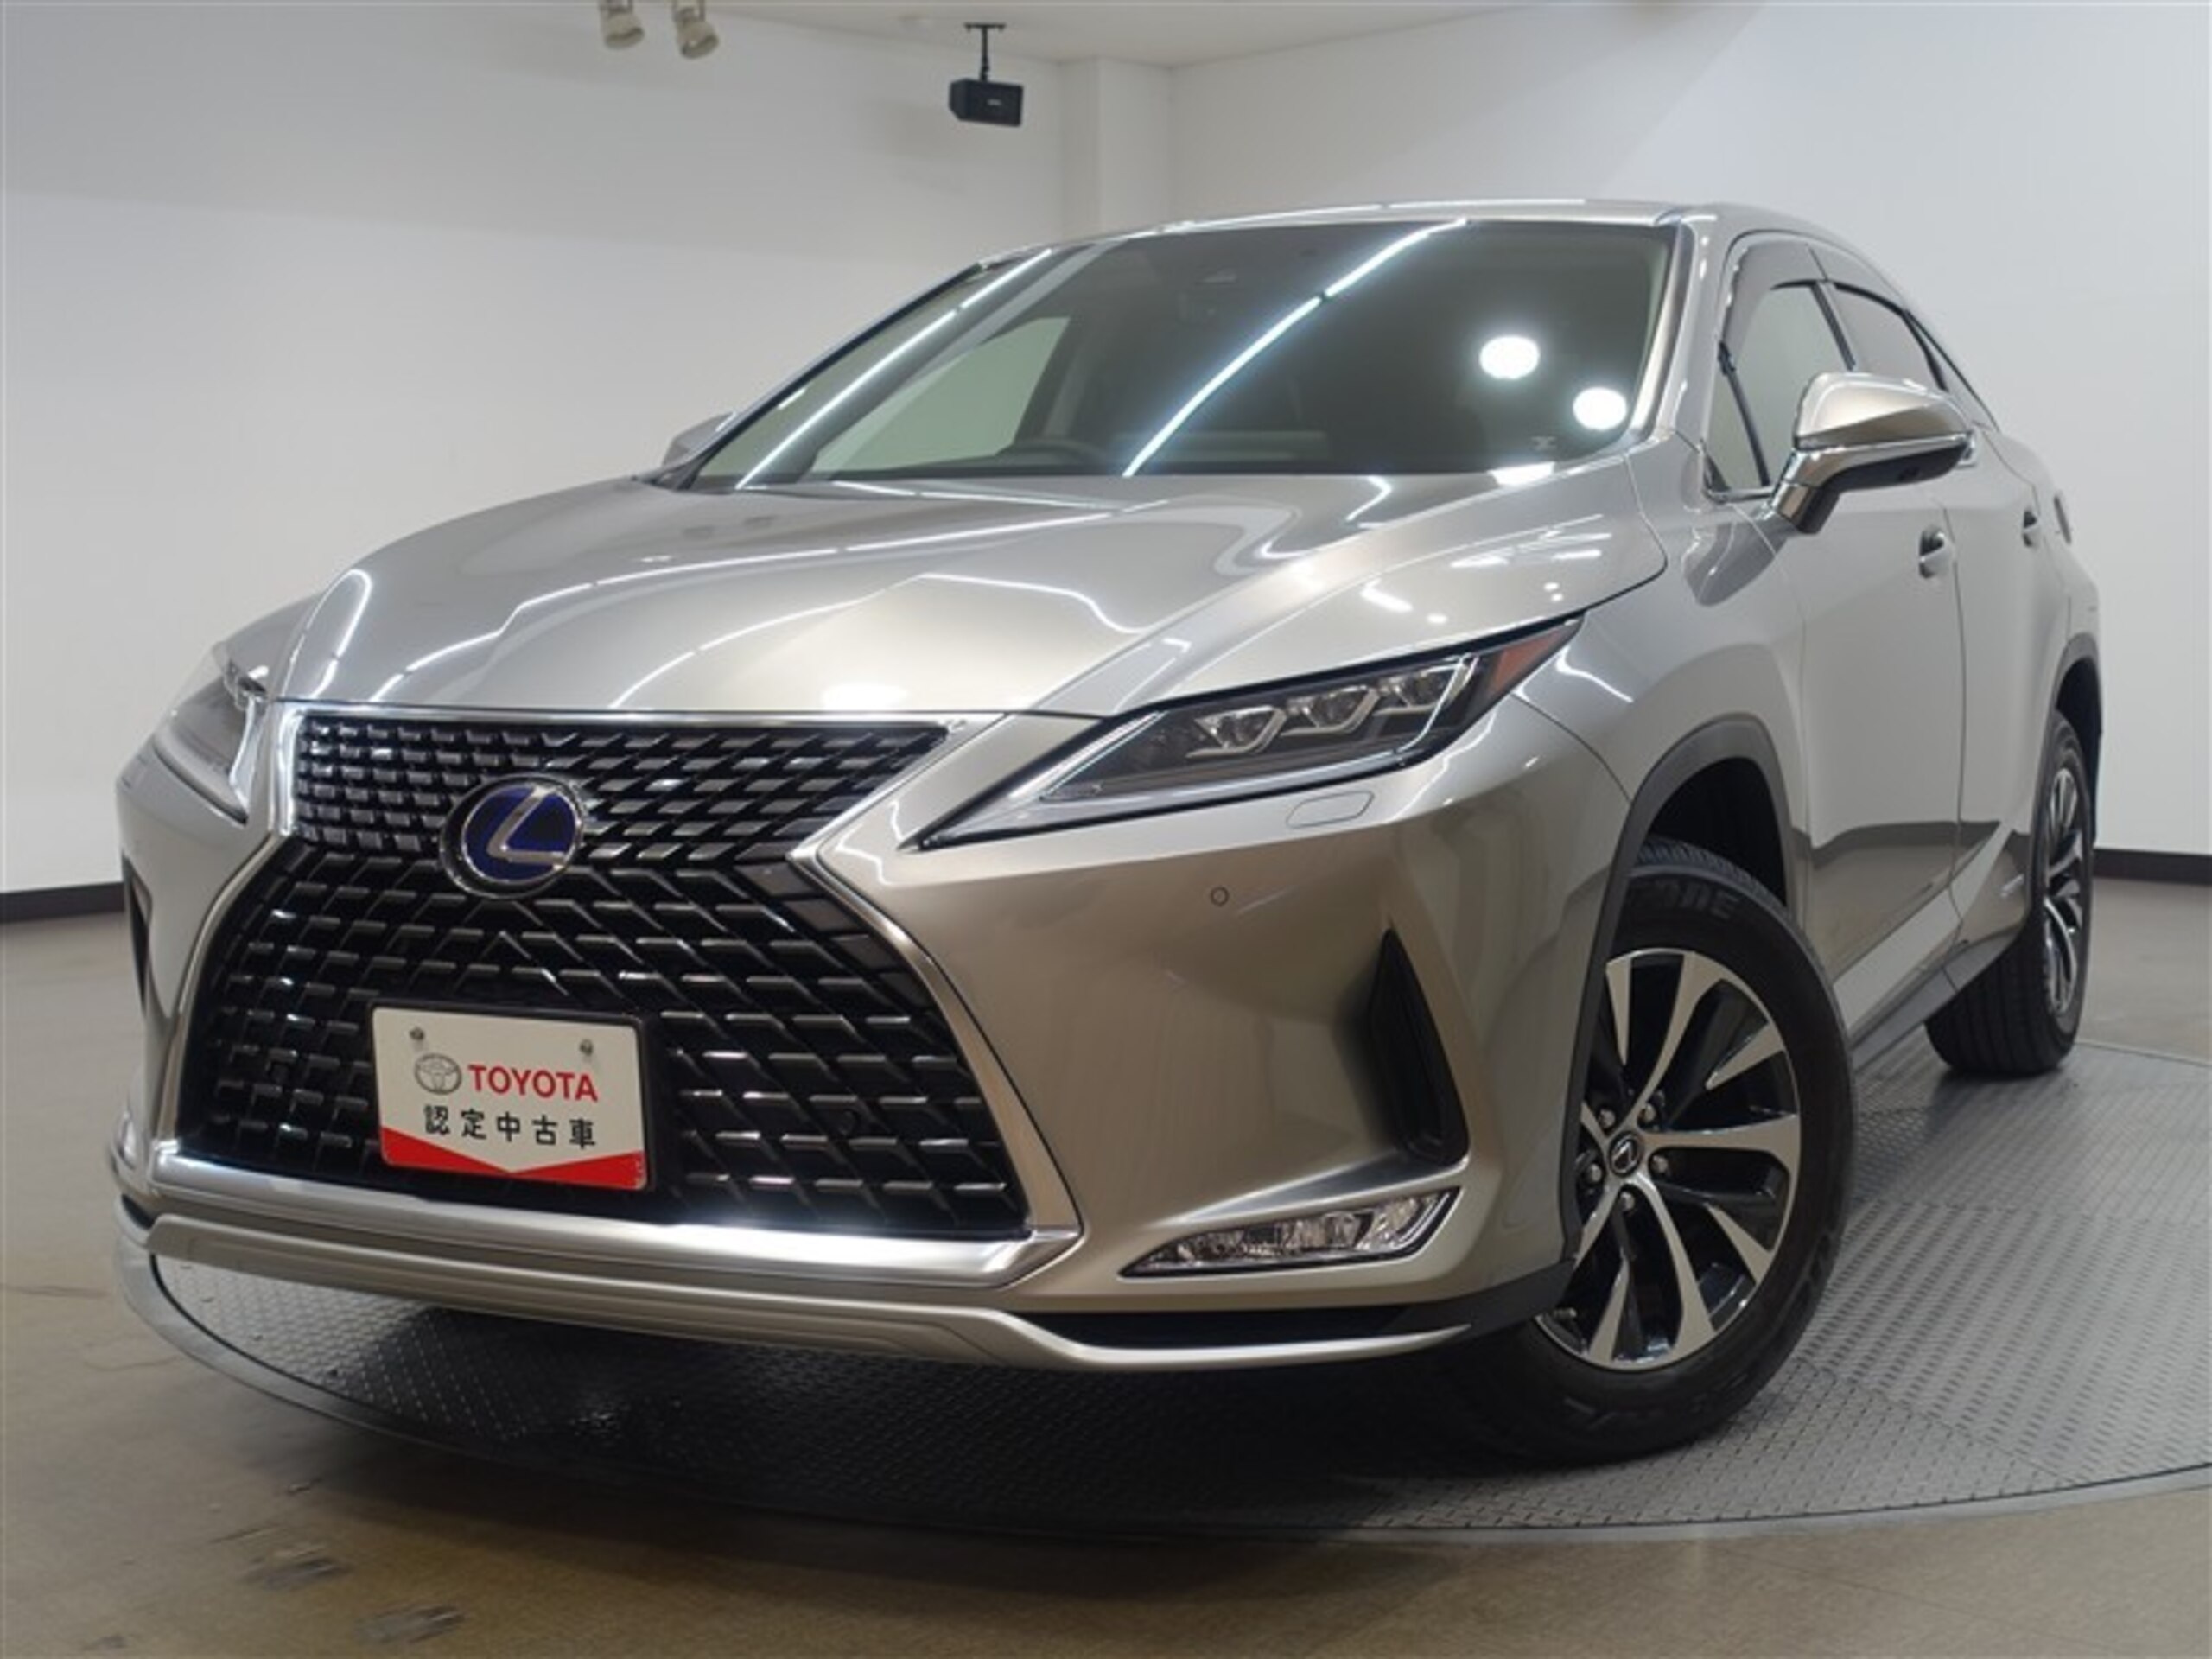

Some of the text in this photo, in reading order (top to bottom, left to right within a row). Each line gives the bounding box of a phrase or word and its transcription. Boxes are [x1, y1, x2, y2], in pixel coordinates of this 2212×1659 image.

[468, 1064, 599, 1103] TOYOTA
[423, 1104, 596, 1149] 認定中古車
